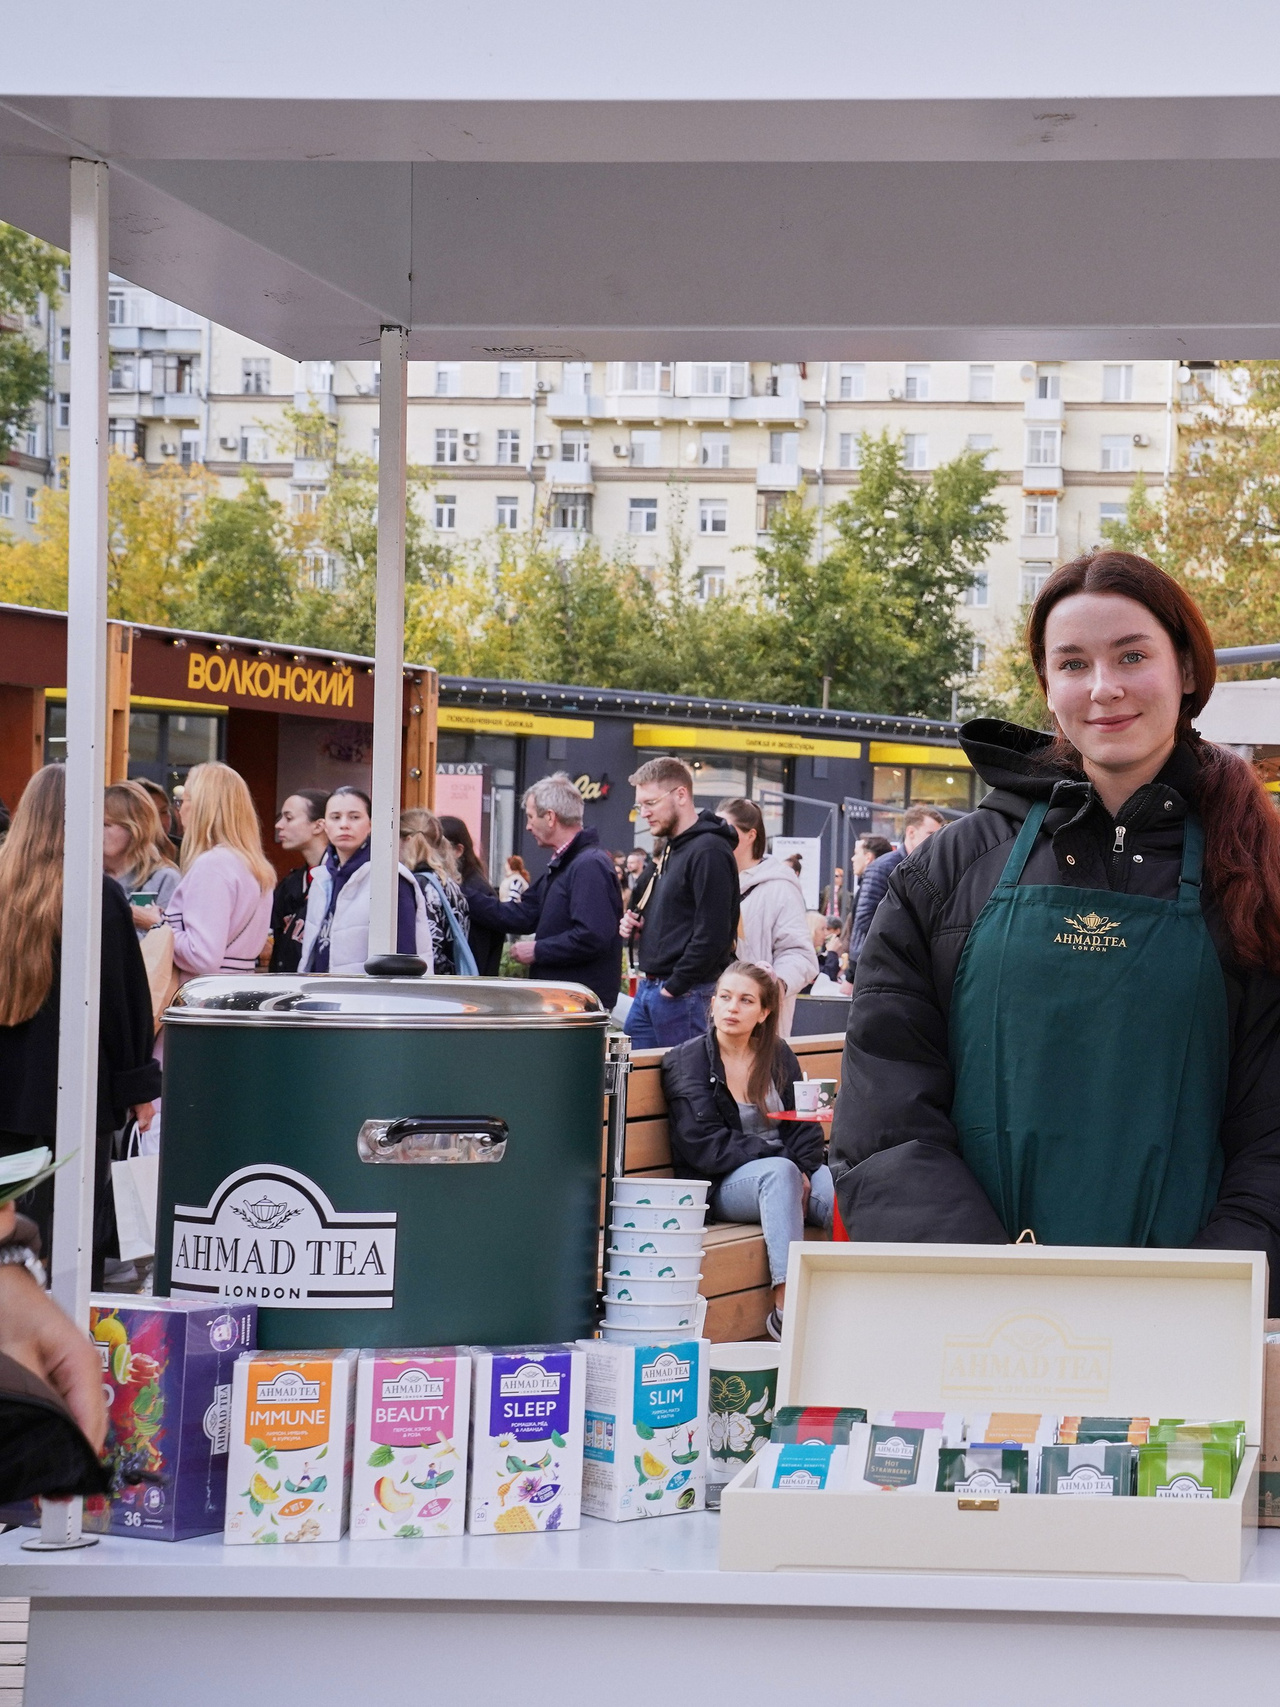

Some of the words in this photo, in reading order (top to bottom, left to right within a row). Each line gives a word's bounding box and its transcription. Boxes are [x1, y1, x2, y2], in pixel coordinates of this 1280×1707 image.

[188, 652, 354, 708] ВОЛКОНСКИЙ
[1054, 933, 1100, 946] AHMAD
[1104, 936, 1127, 948] TEA
[176, 1234, 296, 1274] AHMAD
[306, 1240, 386, 1276] TEA
[225, 1285, 300, 1300] LONDON
[644, 1368, 672, 1378] AHMAD
[674, 1367, 688, 1376] TEA
[951, 1354, 1048, 1379] AHMAD
[1055, 1356, 1103, 1380] TEA
[260, 1388, 297, 1396] AHMAD
[299, 1387, 318, 1396] TEA
[384, 1385, 420, 1394] AHMAD
[424, 1384, 441, 1392] TEA
[503, 1380, 539, 1389] AHMAD
[540, 1379, 558, 1388] TEA
[220, 1386, 228, 1408] TEA
[650, 1388, 684, 1406] SLIM
[376, 1406, 450, 1422] BEAUTY
[504, 1401, 557, 1418] SLEEP
[250, 1410, 326, 1426] IMMUNE
[217, 1410, 227, 1451] AHMAD
[1059, 1482, 1092, 1490] AHMAD
[1096, 1481, 1112, 1490] TEA
[124, 1511, 142, 1527] 36
